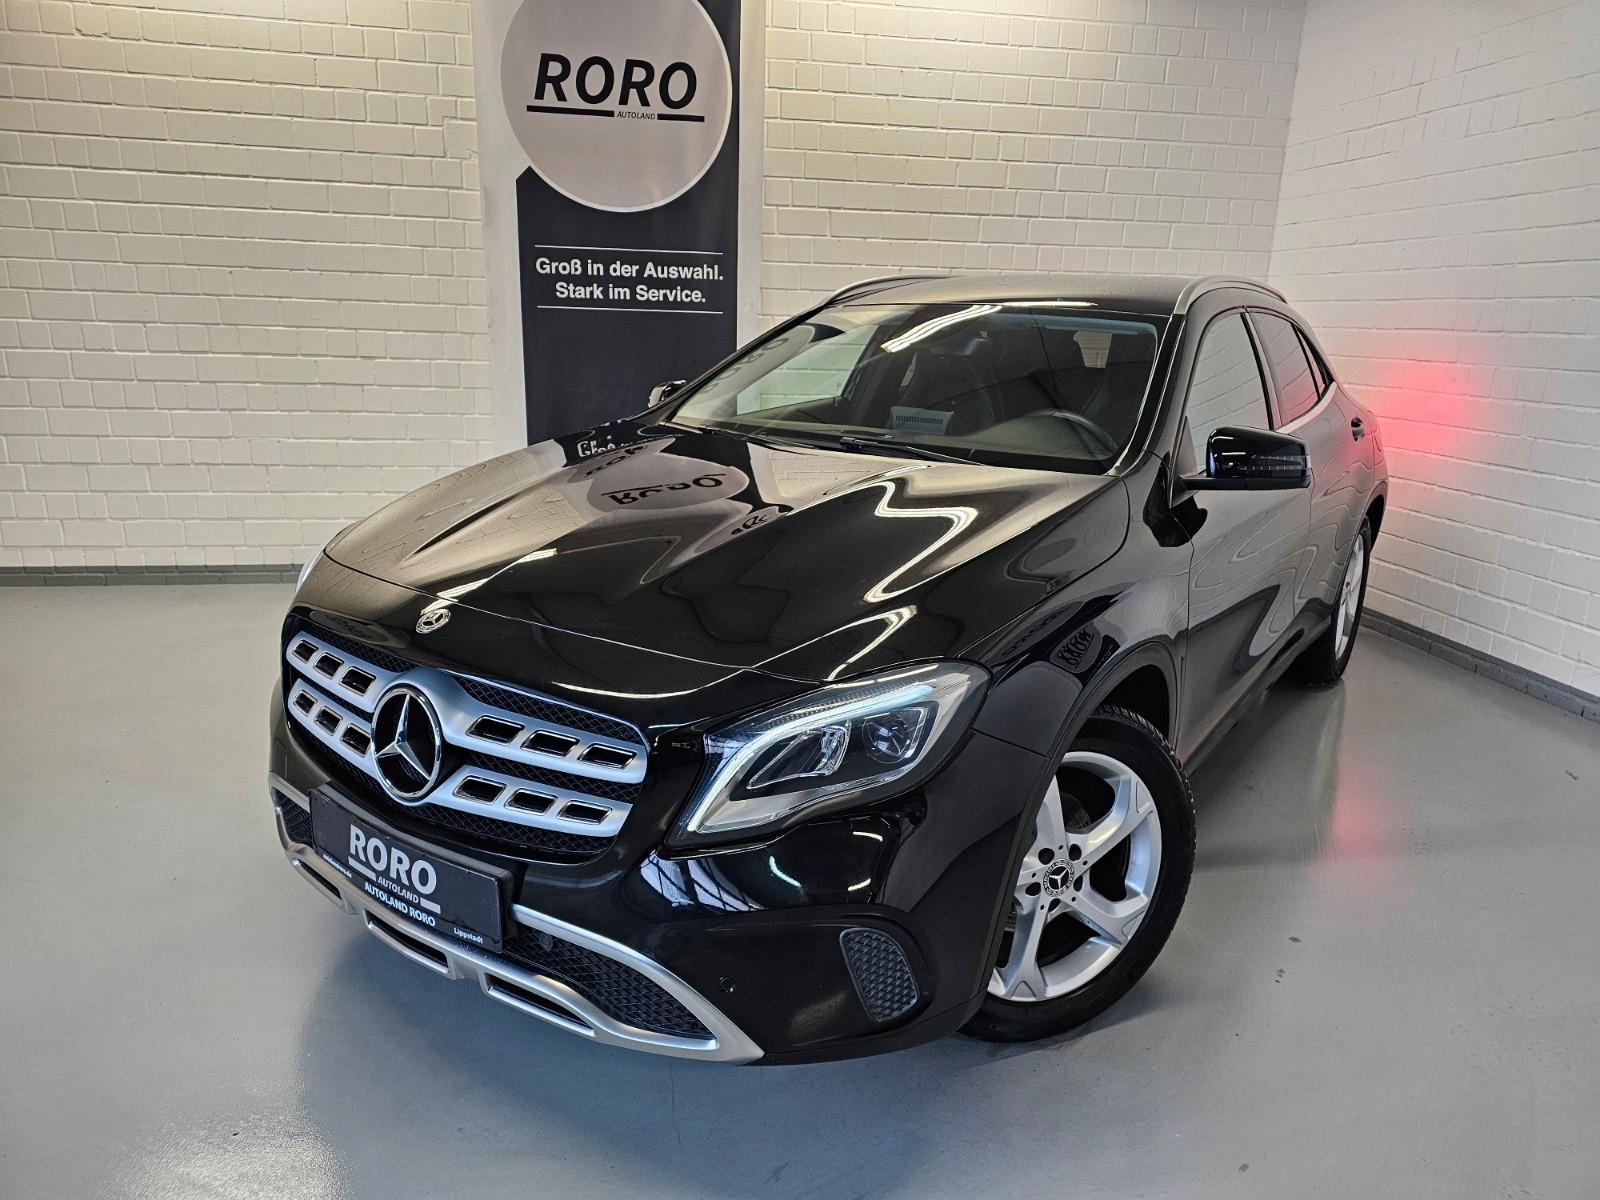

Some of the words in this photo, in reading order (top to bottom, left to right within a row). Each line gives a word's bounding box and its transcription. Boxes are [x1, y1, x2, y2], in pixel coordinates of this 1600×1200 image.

[534, 53, 697, 110] RORO
[616, 111, 656, 120] AUTOLAND
[535, 257, 582, 275] Groß
[587, 260, 604, 276] in
[609, 261, 639, 278] der
[643, 261, 724, 281] Auswahl.
[555, 281, 604, 299] Stark
[608, 284, 630, 300] im
[635, 284, 706, 303] Service.
[350, 824, 437, 895] RORO
[378, 876, 419, 904] AUTOLAND
[365, 882, 409, 914] AUTOLAND
[409, 906, 436, 927] RORO
[453, 927, 484, 944] Lippstadt
